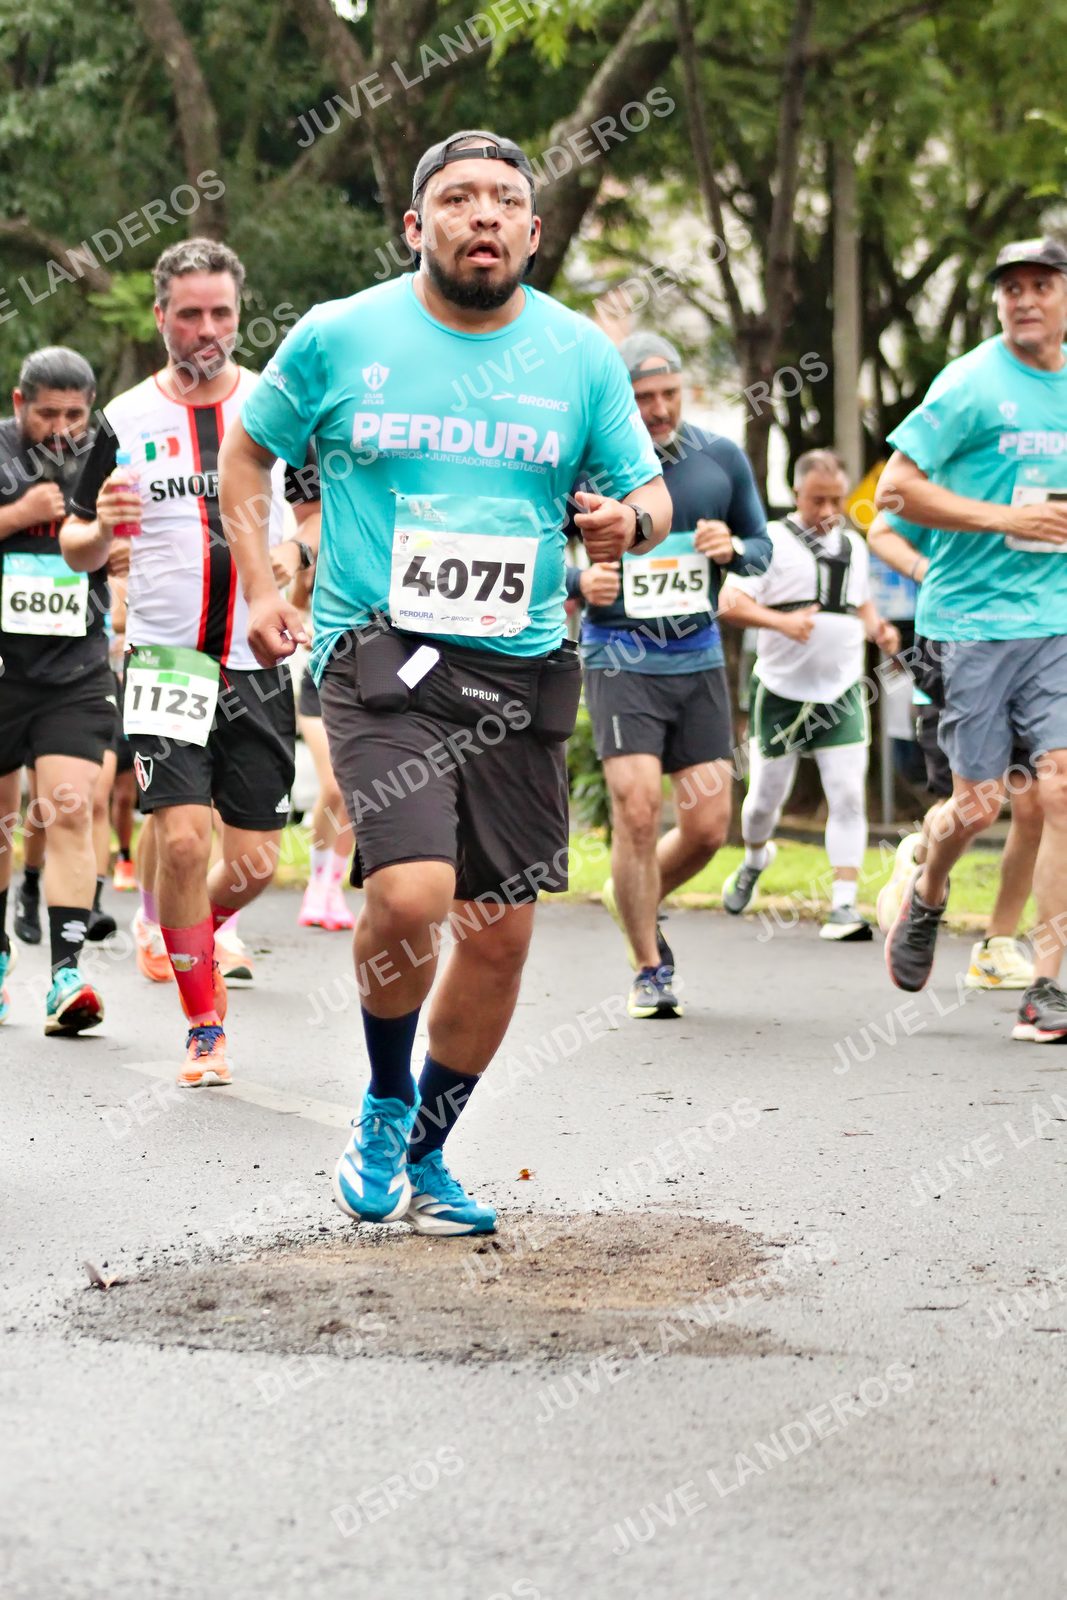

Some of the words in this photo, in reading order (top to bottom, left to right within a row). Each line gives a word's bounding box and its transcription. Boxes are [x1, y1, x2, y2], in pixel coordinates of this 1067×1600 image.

[517, 394, 570, 412] BROOKS
[352, 412, 560, 468] PERDURA
[998, 431, 1067, 455] PERD
[430, 452, 500, 468] JUNTEADORES
[507, 461, 547, 474] ESTUCOS
[402, 556, 525, 603] 4075
[632, 570, 703, 596] 5745
[10, 591, 81, 615] 6804
[399, 609, 434, 620] PERDURA
[132, 685, 209, 720] 1123
[461, 687, 499, 702] KIPRUN
